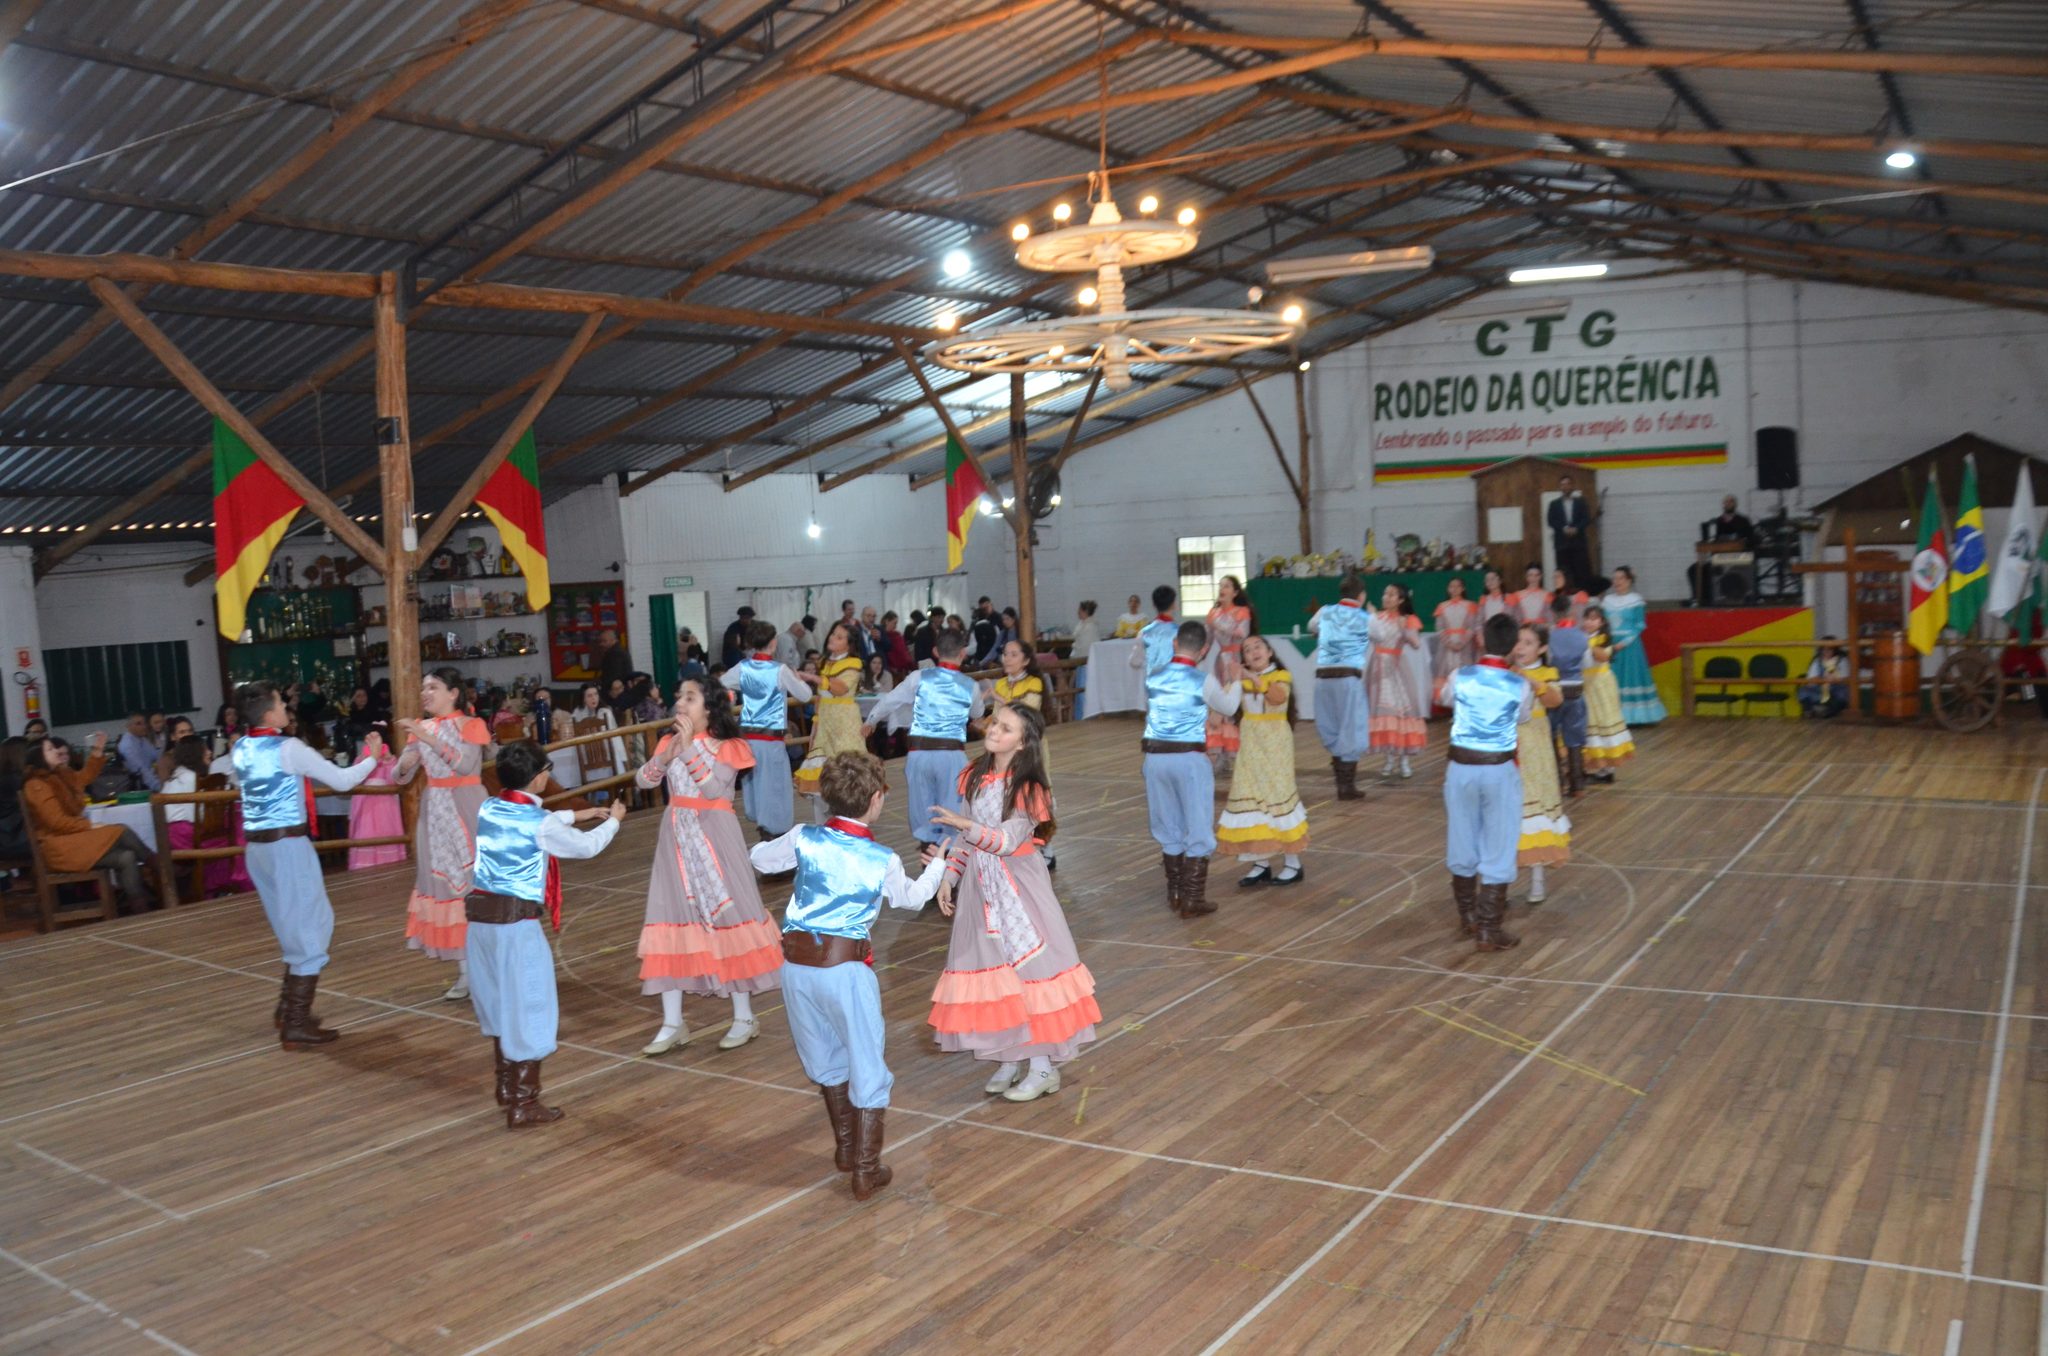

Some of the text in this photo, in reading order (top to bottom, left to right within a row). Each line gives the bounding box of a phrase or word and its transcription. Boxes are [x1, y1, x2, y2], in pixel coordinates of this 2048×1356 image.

[1374, 375, 1478, 421] RODEIO
[1486, 371, 1525, 411] DA
[1375, 427, 1450, 450] Lembrando
[1453, 431, 1463, 444] o
[1465, 423, 1523, 451] passado
[1527, 425, 1563, 448] para
[1568, 416, 1627, 442] exemplo
[1633, 413, 1653, 433] do
